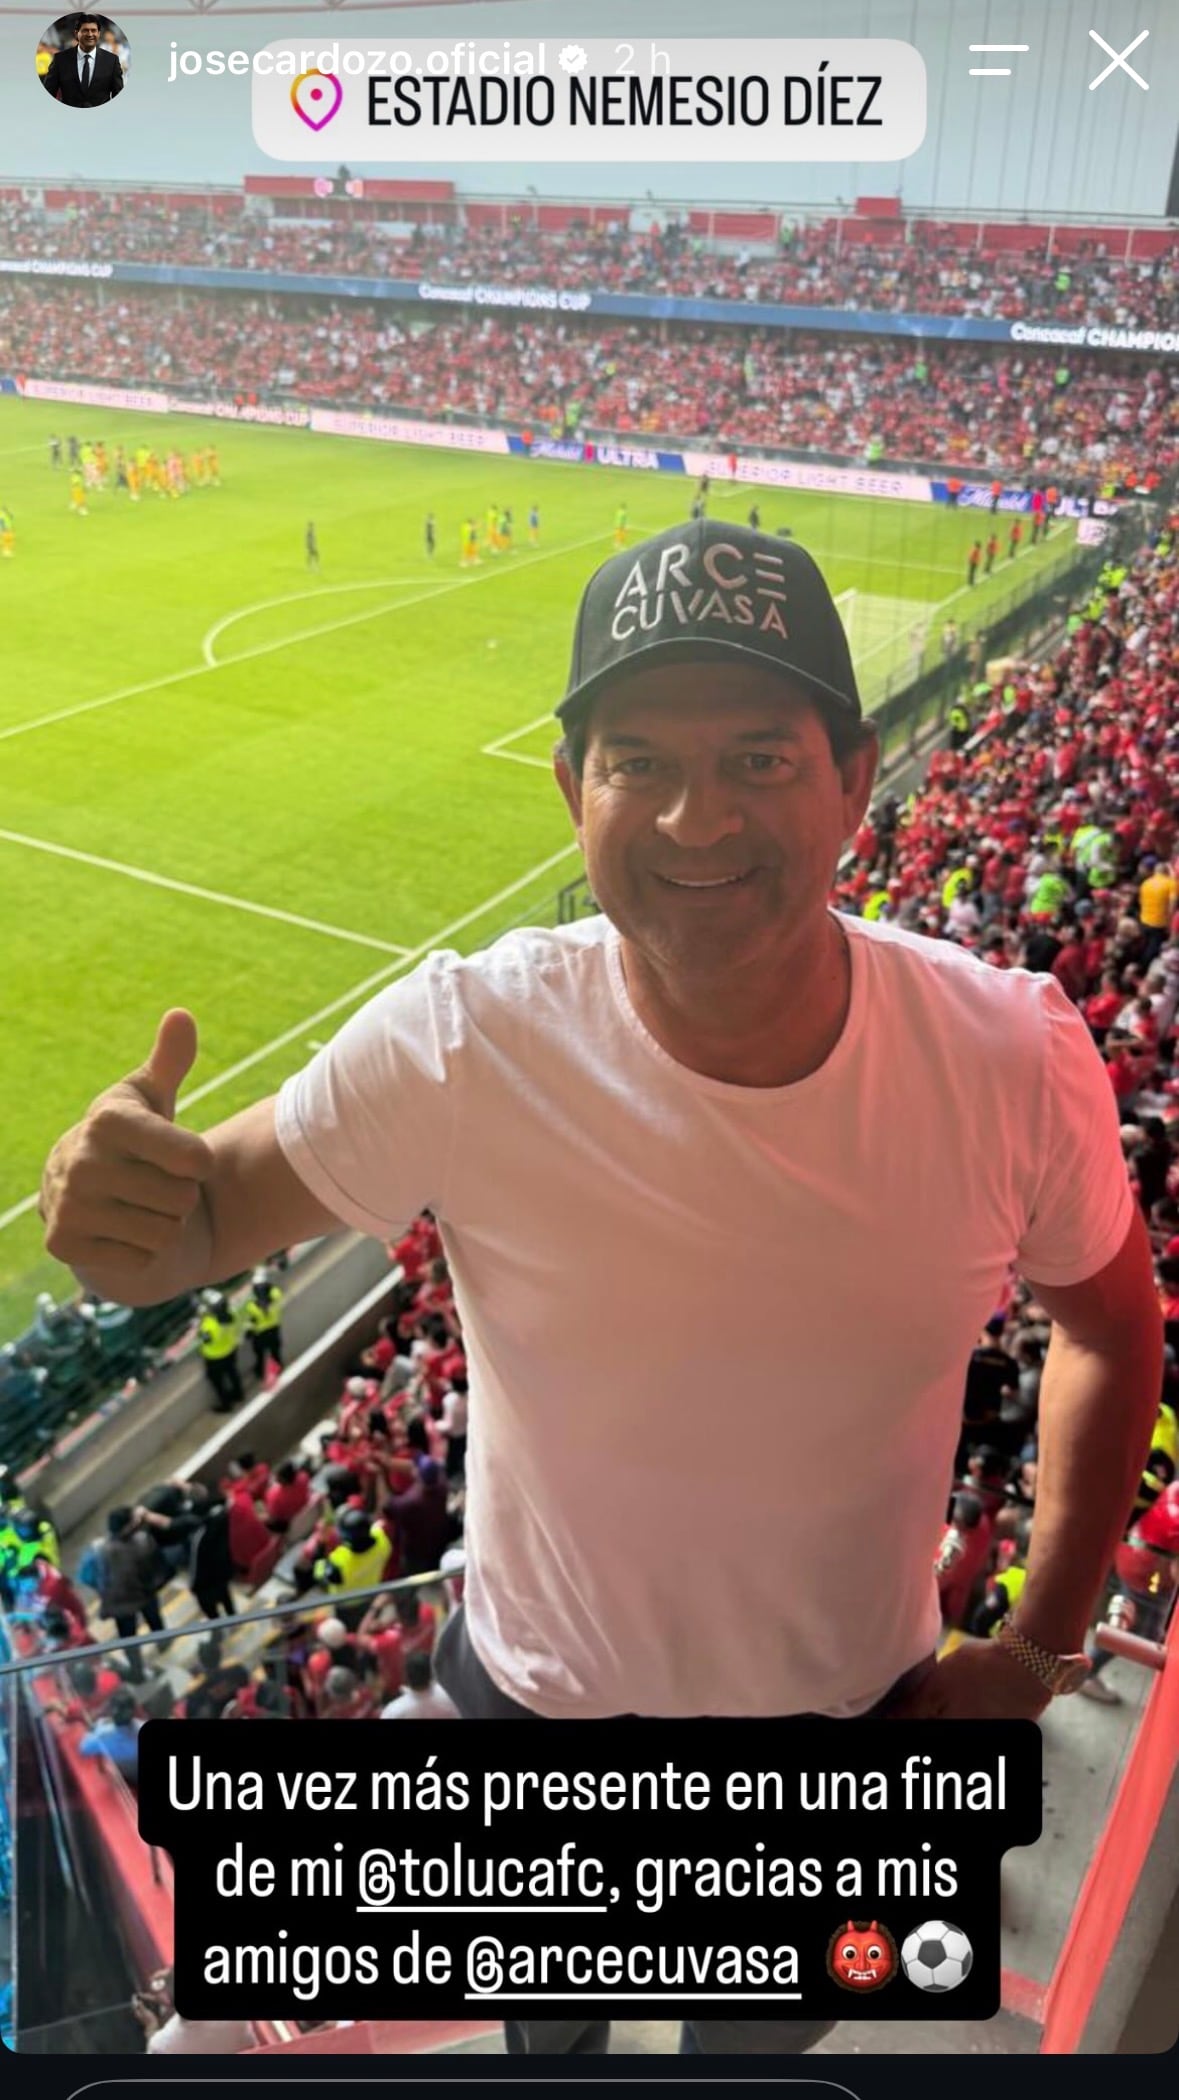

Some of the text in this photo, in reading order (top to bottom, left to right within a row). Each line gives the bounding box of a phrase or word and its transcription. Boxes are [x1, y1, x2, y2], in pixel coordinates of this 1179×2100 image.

[1087, 328, 1179, 351] CHAMPIO
[614, 542, 788, 608] ARCE
[610, 588, 789, 641] CUVASA
